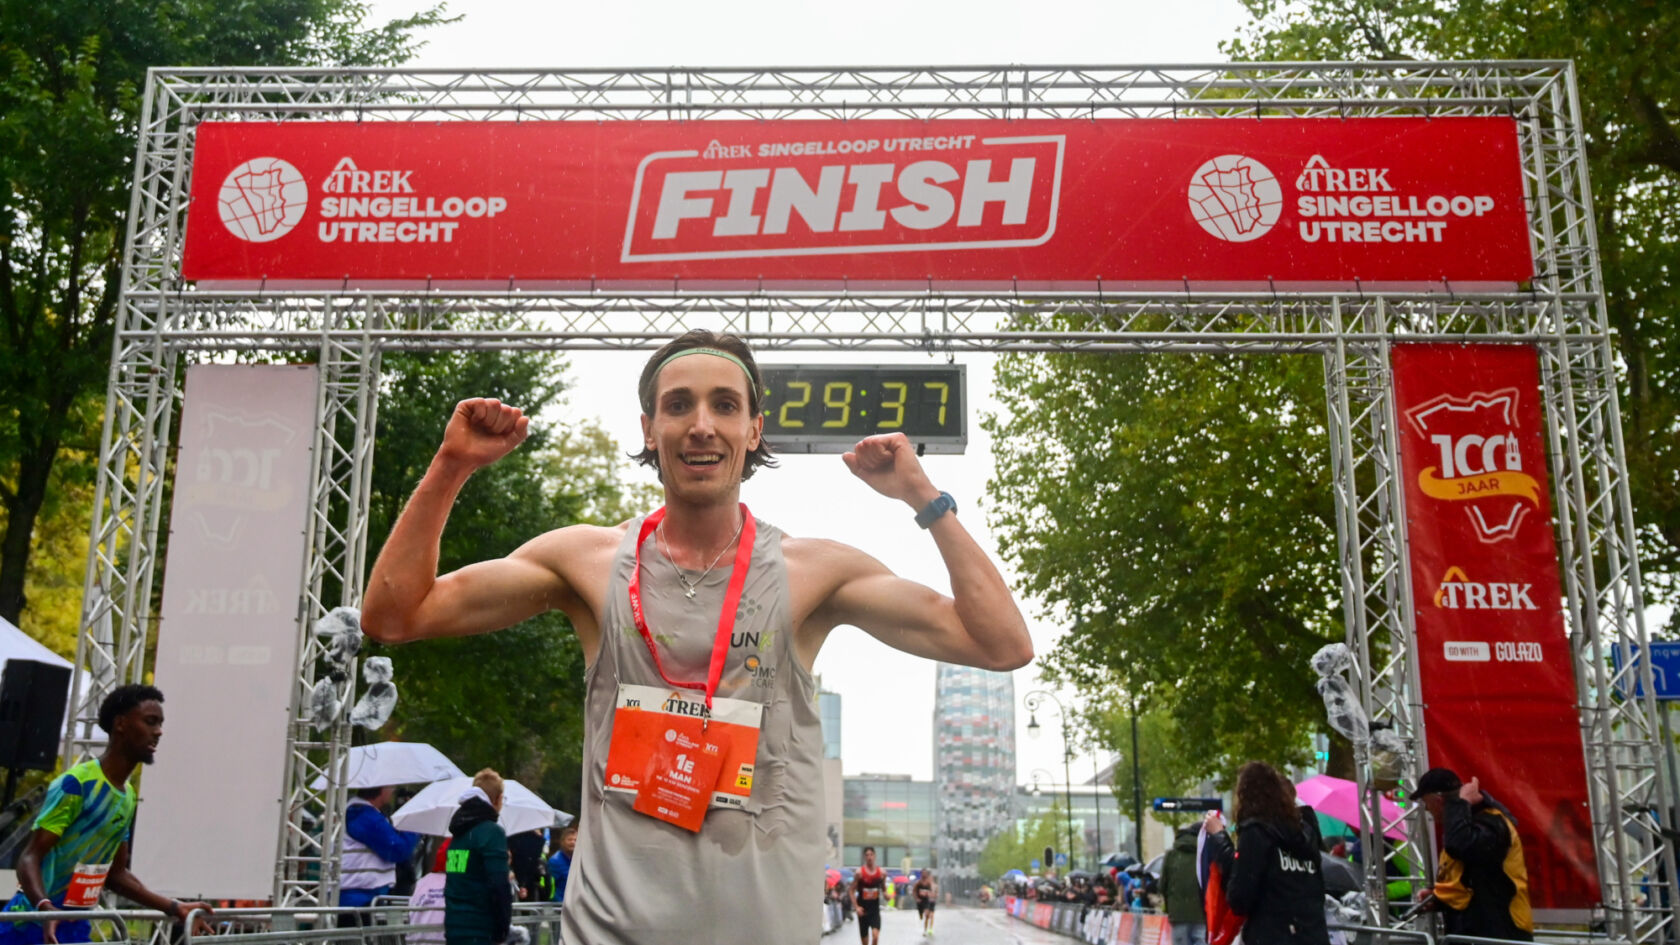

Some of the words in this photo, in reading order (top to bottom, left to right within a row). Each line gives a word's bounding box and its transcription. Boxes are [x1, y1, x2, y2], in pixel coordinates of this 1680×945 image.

[706, 142, 752, 159] TREK
[758, 139, 880, 157] SINGELLOOP
[883, 135, 976, 152] UTRECHT
[327, 167, 414, 194] TREK
[1300, 165, 1395, 193] TREK
[320, 197, 507, 218] SINGELLOOP
[651, 157, 1037, 239] FINISH
[1297, 196, 1495, 217] SINGELLOOP
[319, 222, 459, 242] UTRECHT
[1300, 221, 1447, 243] UTRECHT
[1458, 478, 1500, 495] JAAR
[1438, 580, 1538, 610] TREK
[1460, 646, 1479, 657] WITH
[1495, 641, 1543, 662] GOLAZO
[676, 754, 695, 774] 1E
[669, 770, 692, 784] MAN
